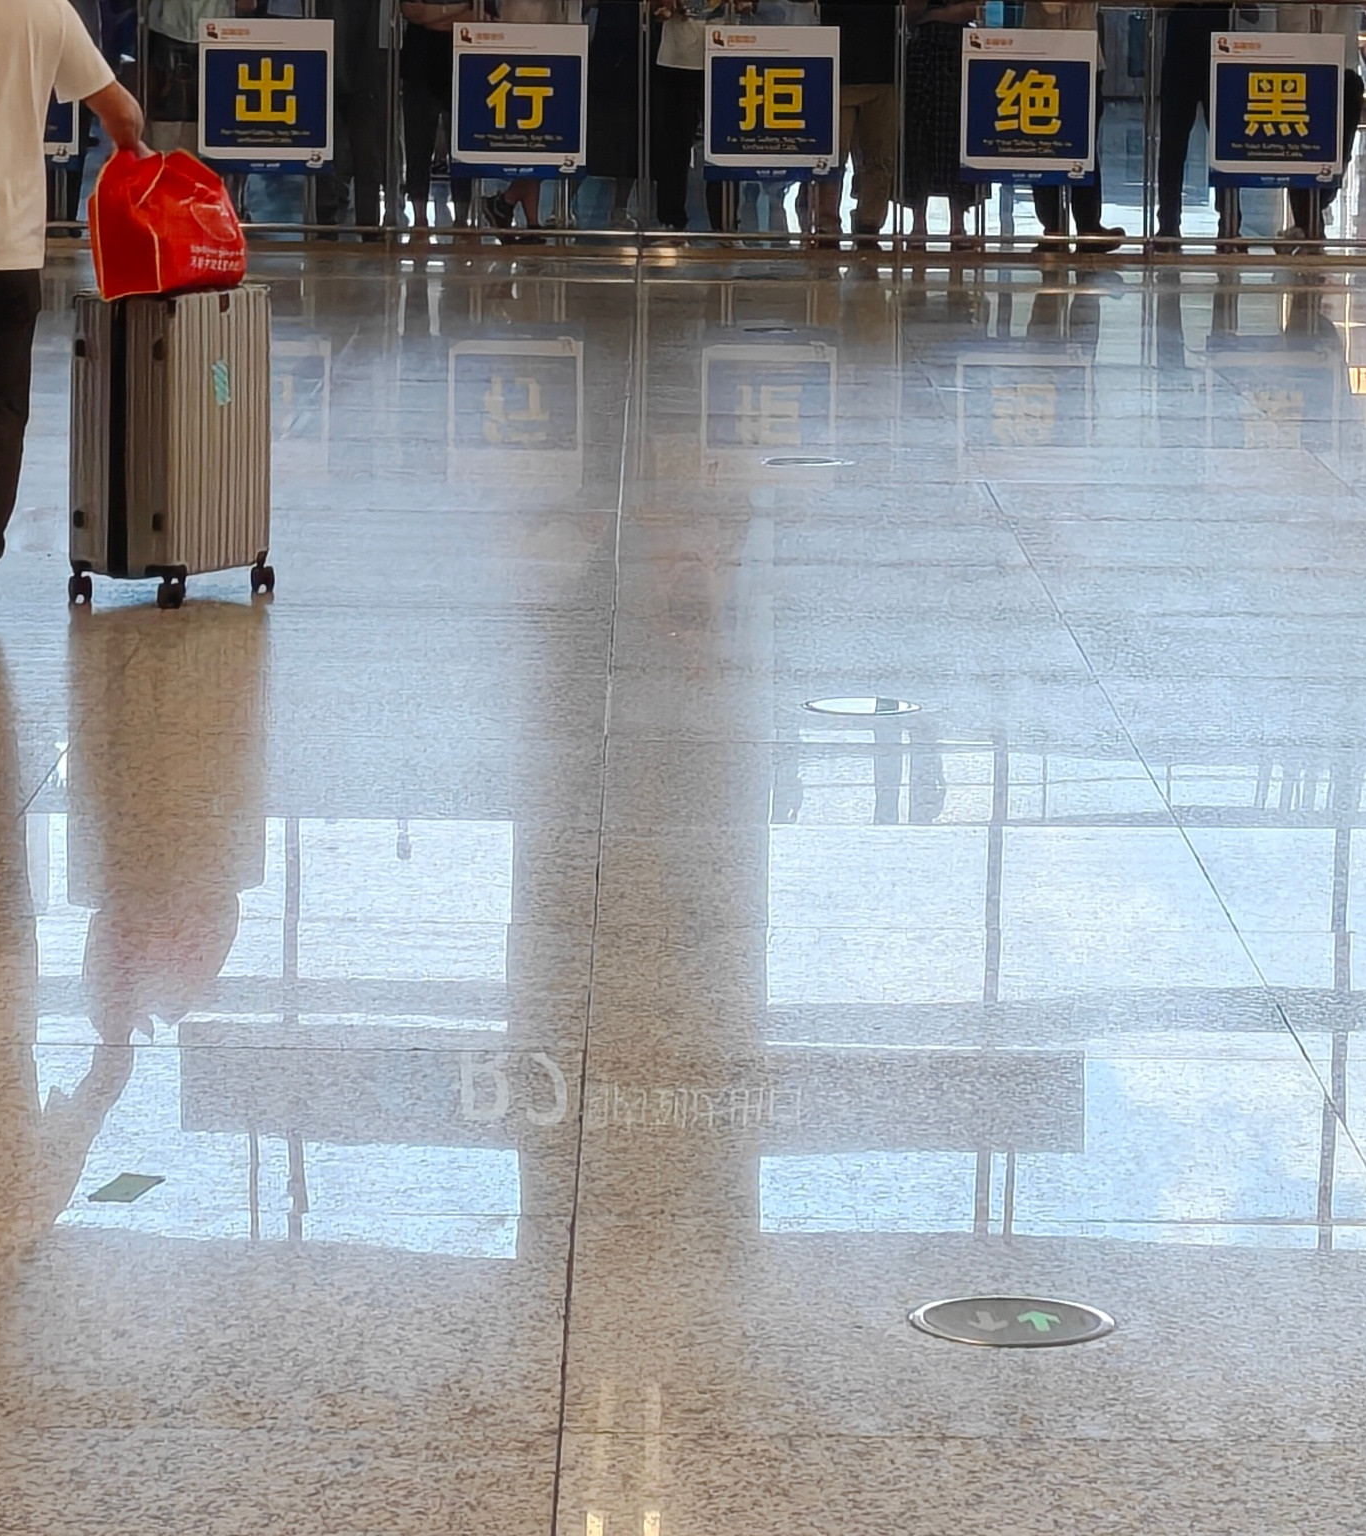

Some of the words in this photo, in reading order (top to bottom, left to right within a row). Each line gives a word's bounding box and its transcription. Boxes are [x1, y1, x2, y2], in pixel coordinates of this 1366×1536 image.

[236, 57, 297, 125] 出
[486, 63, 554, 129] 行
[739, 65, 806, 131] 拒
[994, 68, 1062, 134] 绝
[1243, 72, 1310, 137] 黑
